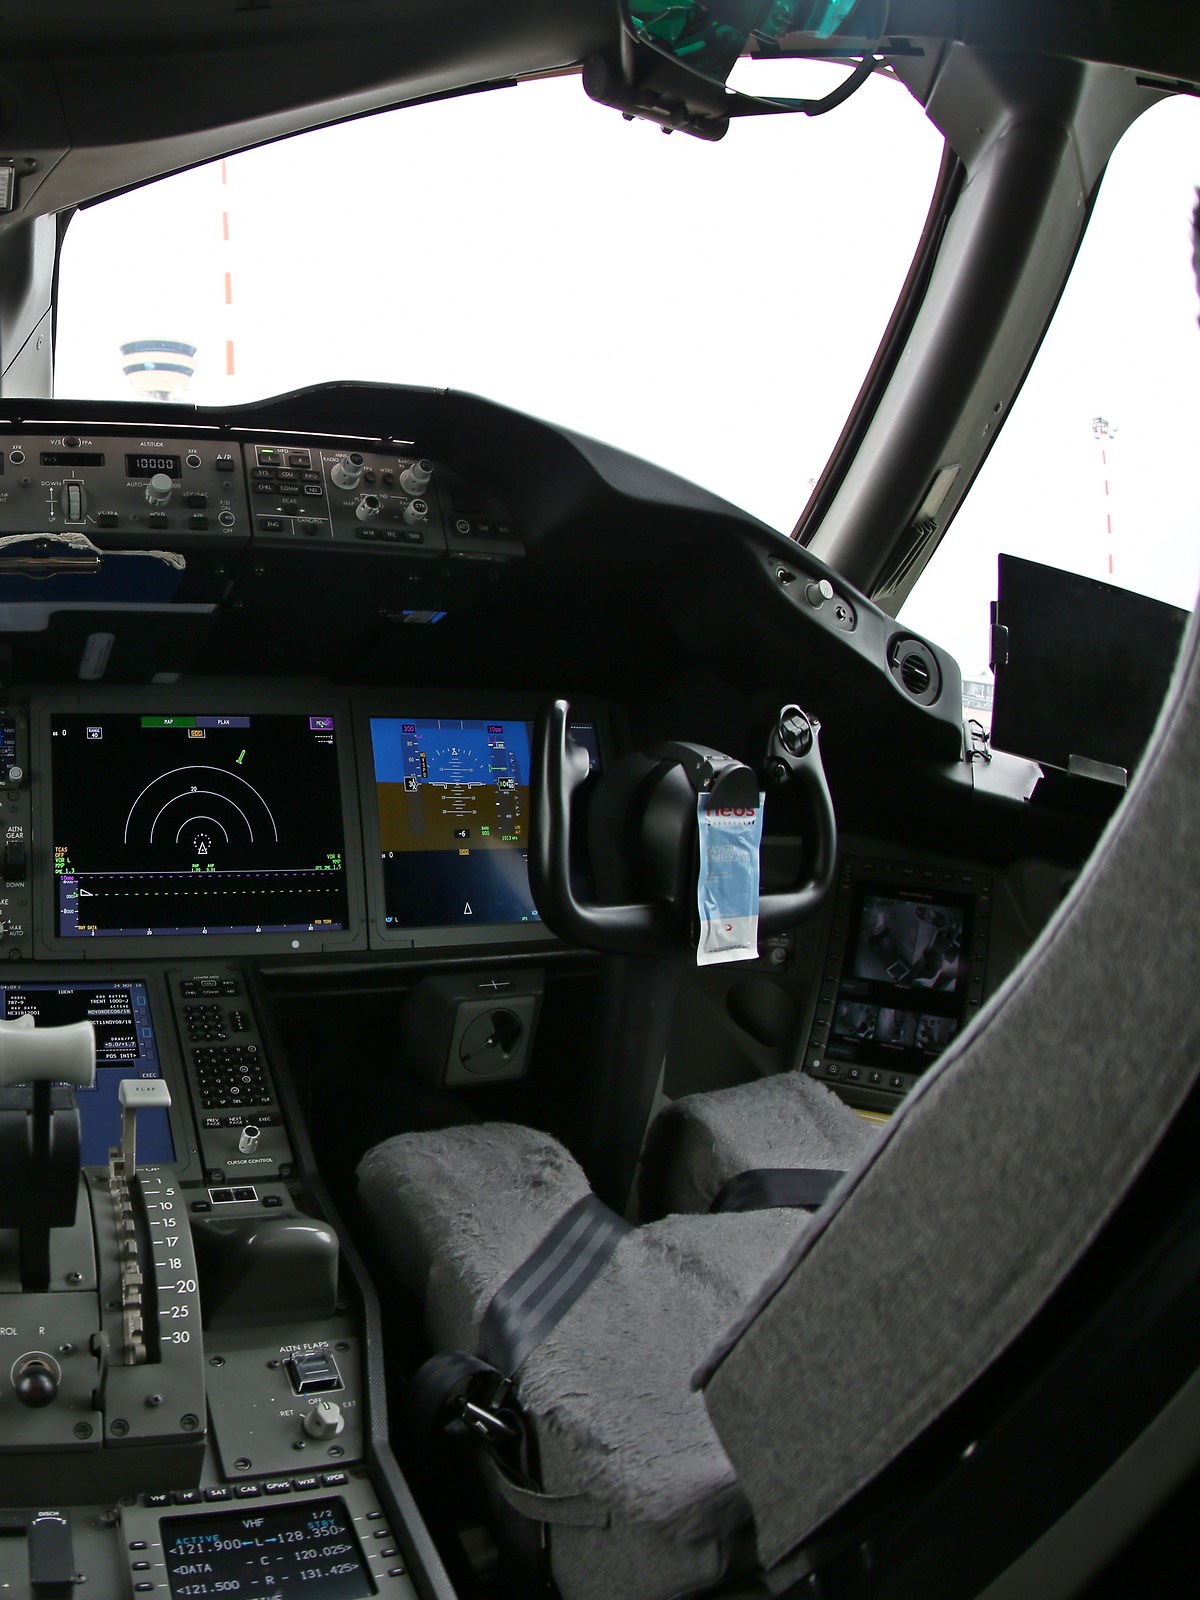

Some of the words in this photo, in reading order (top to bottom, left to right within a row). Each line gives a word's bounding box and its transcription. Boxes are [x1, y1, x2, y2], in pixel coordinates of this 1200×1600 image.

[136, 459, 173, 468] 10000
[165, 1188, 175, 1196] 5
[160, 1202, 173, 1210] 10
[163, 1218, 176, 1227] 15
[165, 1237, 179, 1247] 17
[168, 1258, 182, 1269] 18
[175, 1280, 196, 1293] 20
[171, 1306, 189, 1319] 25
[39, 1327, 45, 1335] R
[172, 1331, 190, 1344] 30
[279, 1345, 300, 1353] ALTN
[303, 1341, 329, 1350] FLAPS
[280, 1409, 294, 1417] RET
[312, 1510, 333, 1519] 1/2
[242, 1518, 264, 1528] VHF
[307, 1519, 336, 1529] STBY
[176, 1534, 220, 1545] ACTIVE
[255, 1538, 264, 1547] L
[260, 1556, 269, 1565] C
[265, 1576, 275, 1585] R
